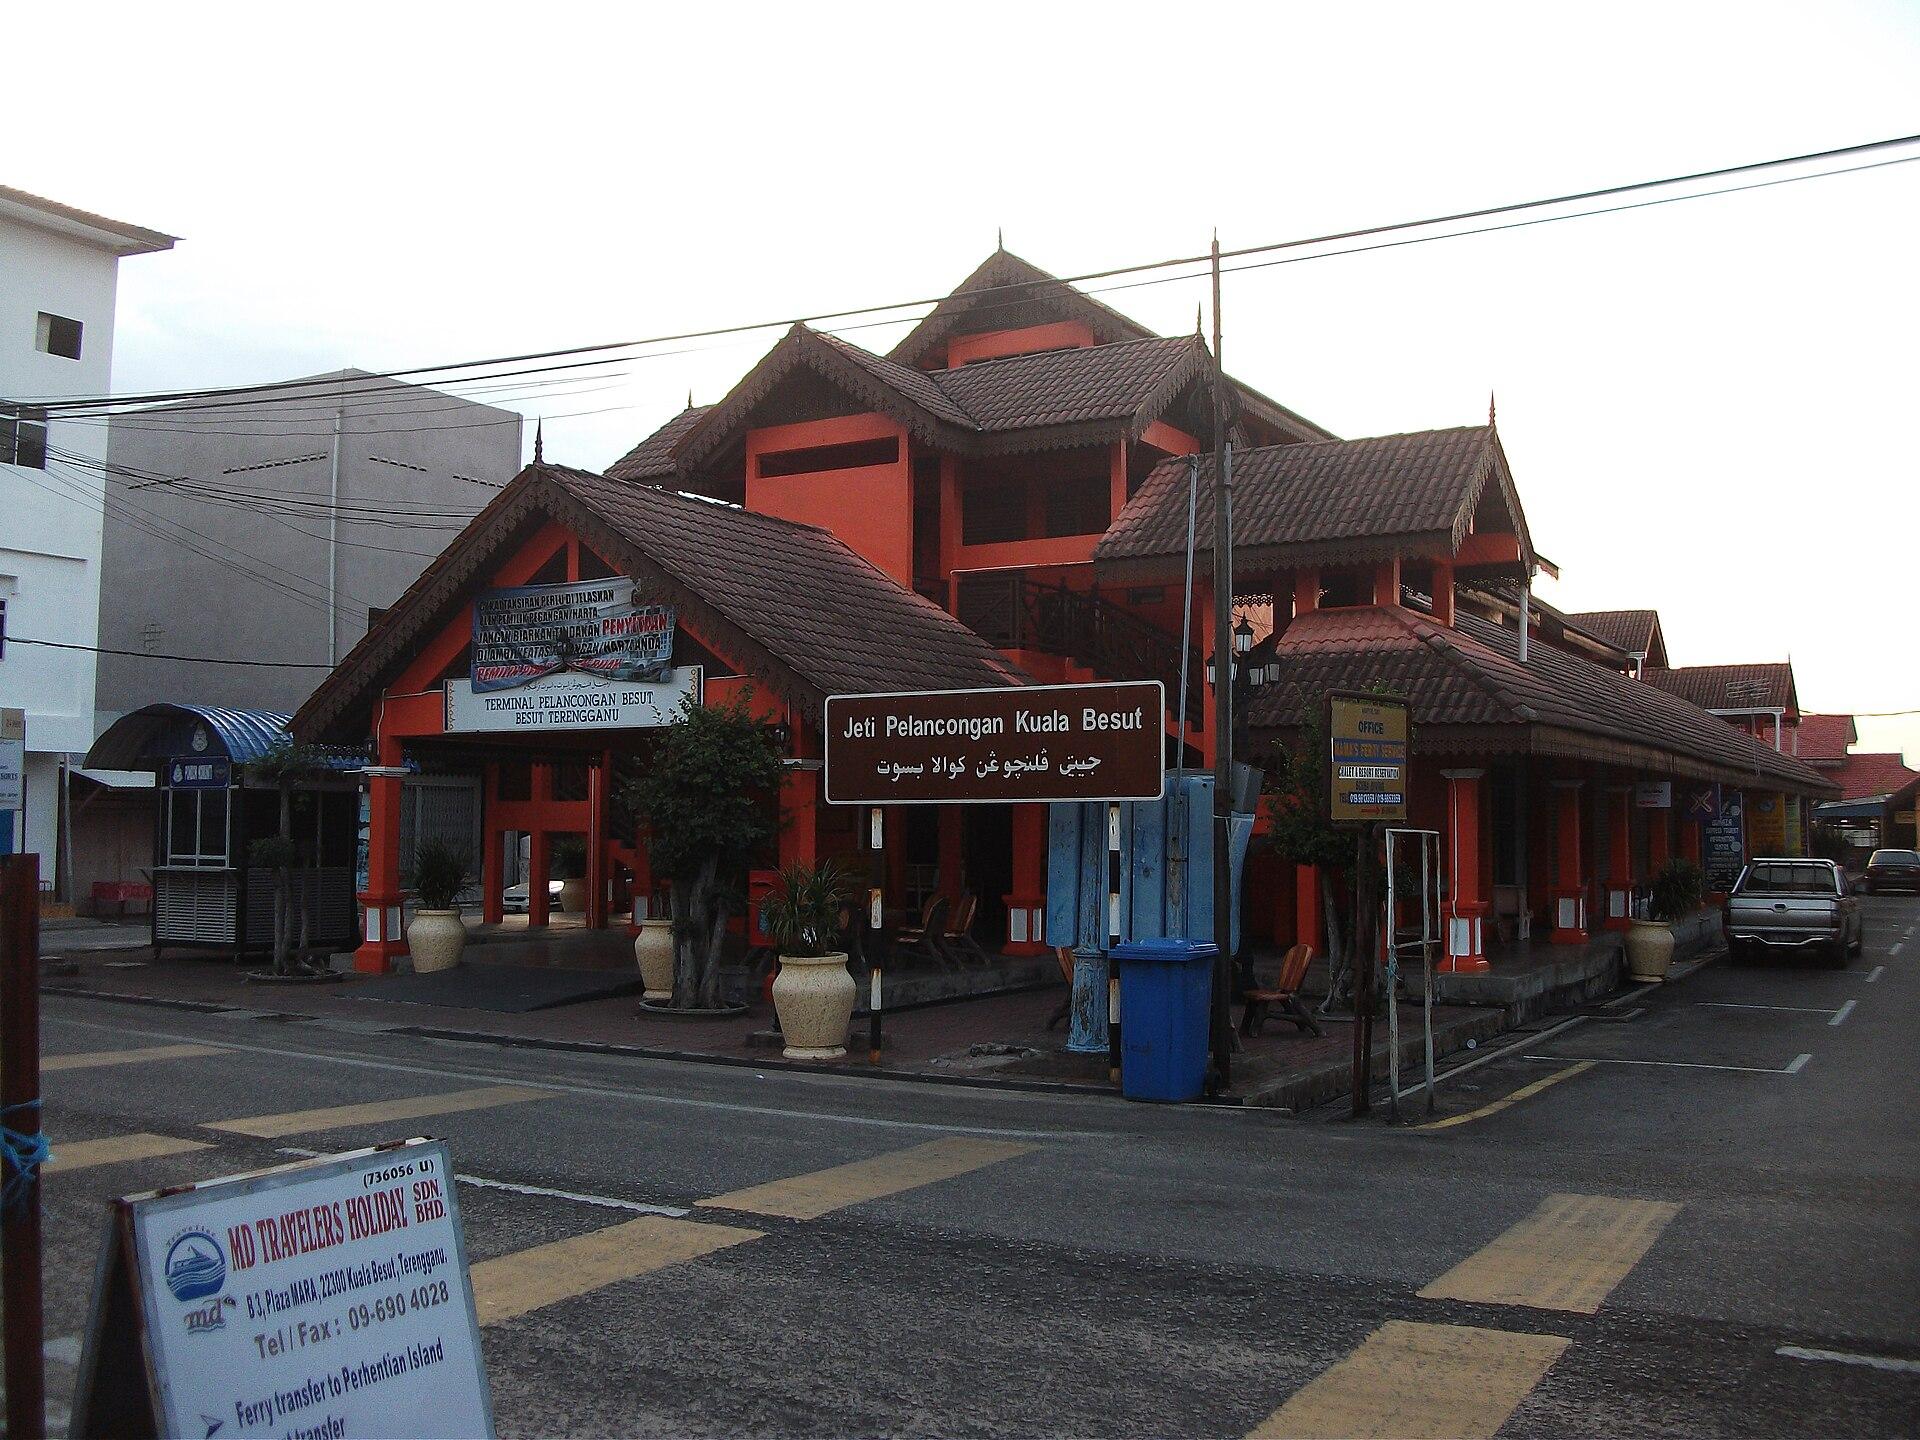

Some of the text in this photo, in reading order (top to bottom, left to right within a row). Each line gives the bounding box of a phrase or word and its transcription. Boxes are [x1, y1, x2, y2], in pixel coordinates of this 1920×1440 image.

[485, 691, 654, 711] TERMINAL PELANCONGAN BESUT
[516, 709, 619, 724] BESUT TERENGGANU
[844, 707, 1142, 740] Jeti Pelancongan Kuala Besut
[877, 757, 923, 782] بسوت
[363, 1159, 434, 1188] (736056 U)
[412, 1179, 443, 1202] SDN.
[415, 1199, 447, 1223] BHD.
[227, 1187, 408, 1271] MD TRAVELERS HOLIDAY
[265, 1288, 291, 1314] Plaza
[290, 1277, 321, 1306] MARA,
[319, 1269, 347, 1298] 22300
[346, 1264, 371, 1288] Kuala
[371, 1258, 401, 1283] Besut,
[397, 1248, 448, 1276] Terengganu.
[254, 1329, 285, 1359] Tel
[348, 1293, 406, 1331] 09-690
[410, 1280, 450, 1311] 4028
[235, 1336, 444, 1428] Ferry transfer to Perhentian Island
